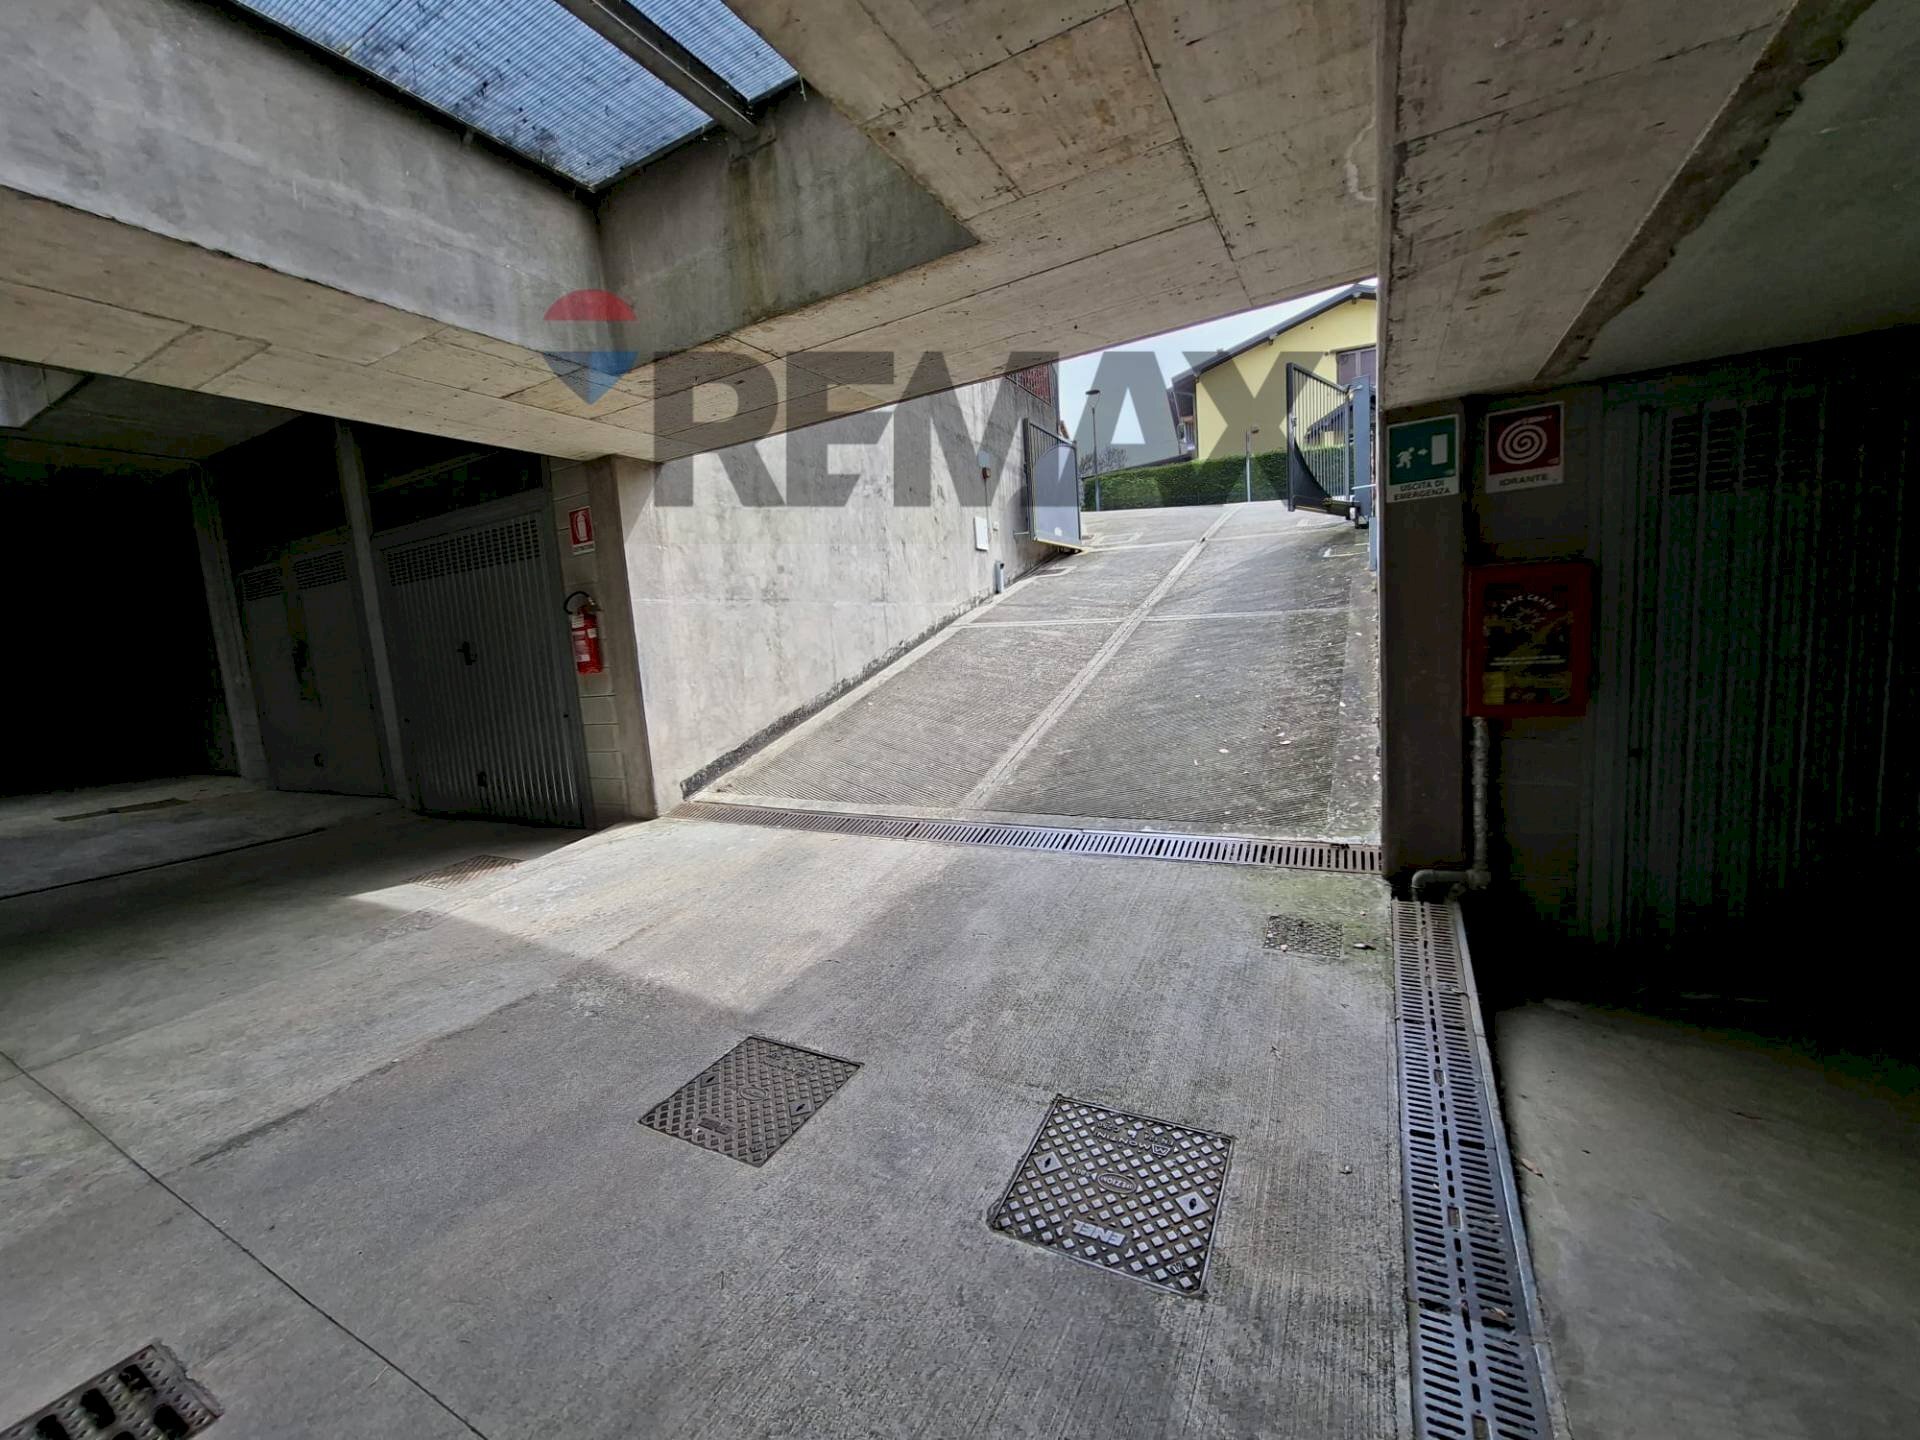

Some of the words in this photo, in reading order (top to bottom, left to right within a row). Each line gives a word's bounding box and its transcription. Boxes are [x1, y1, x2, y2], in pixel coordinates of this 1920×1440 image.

[1399, 480, 1433, 492] USCITA
[1434, 479, 1445, 488] DI
[1499, 474, 1548, 486] IDRANTE
[1394, 487, 1451, 501] EMERGENZA
[1072, 1219, 1126, 1247] ENEL
